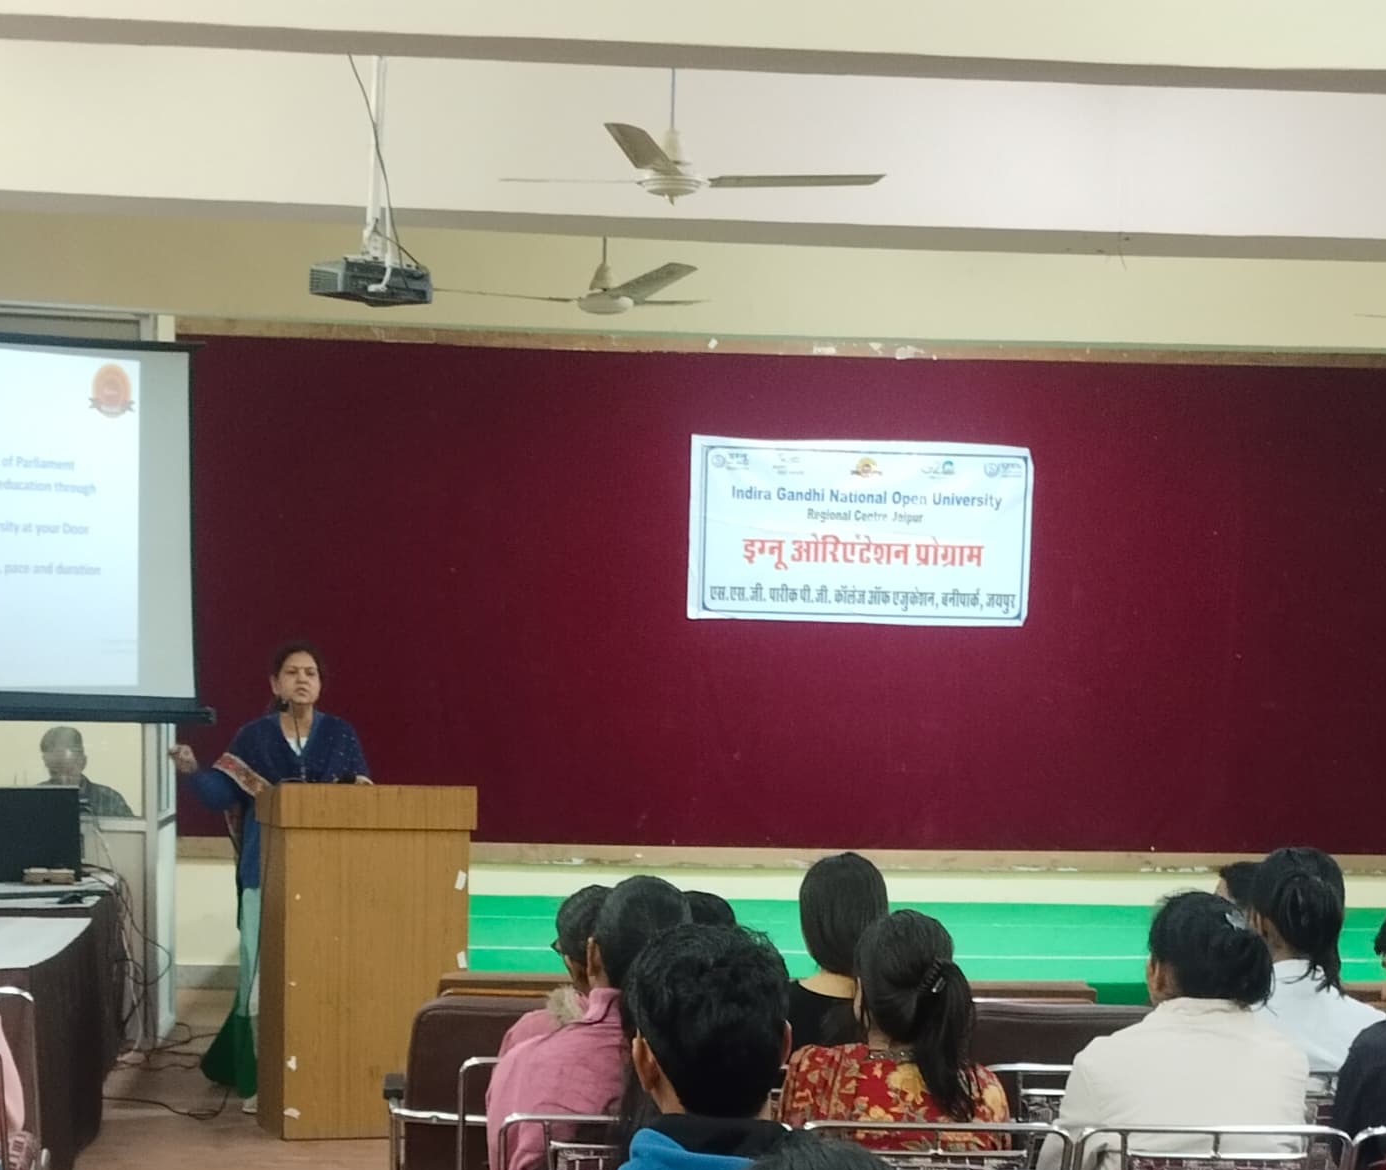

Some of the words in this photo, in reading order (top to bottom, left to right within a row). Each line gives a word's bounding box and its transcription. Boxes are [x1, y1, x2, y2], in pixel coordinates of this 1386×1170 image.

[1, 455, 14, 467] of
[15, 456, 75, 471] Parliament
[731, 485, 772, 501] Indira
[776, 487, 825, 502] Gandhi
[829, 489, 887, 505] National
[892, 491, 928, 508] Open
[932, 493, 1003, 511] University
[807, 508, 851, 523] Regional
[854, 510, 888, 522] Centre
[891, 511, 924, 526] Jaipur
[21, 522, 33, 533] at
[34, 524, 60, 536] your
[62, 522, 89, 535] Door
[743, 539, 789, 571] इग्नू
[915, 536, 984, 567] प्रोग्राम
[32, 561, 54, 575] and
[769, 584, 799, 603] पारीक
[867, 586, 891, 605] ऑफ
[986, 593, 1017, 615] जयपुर
